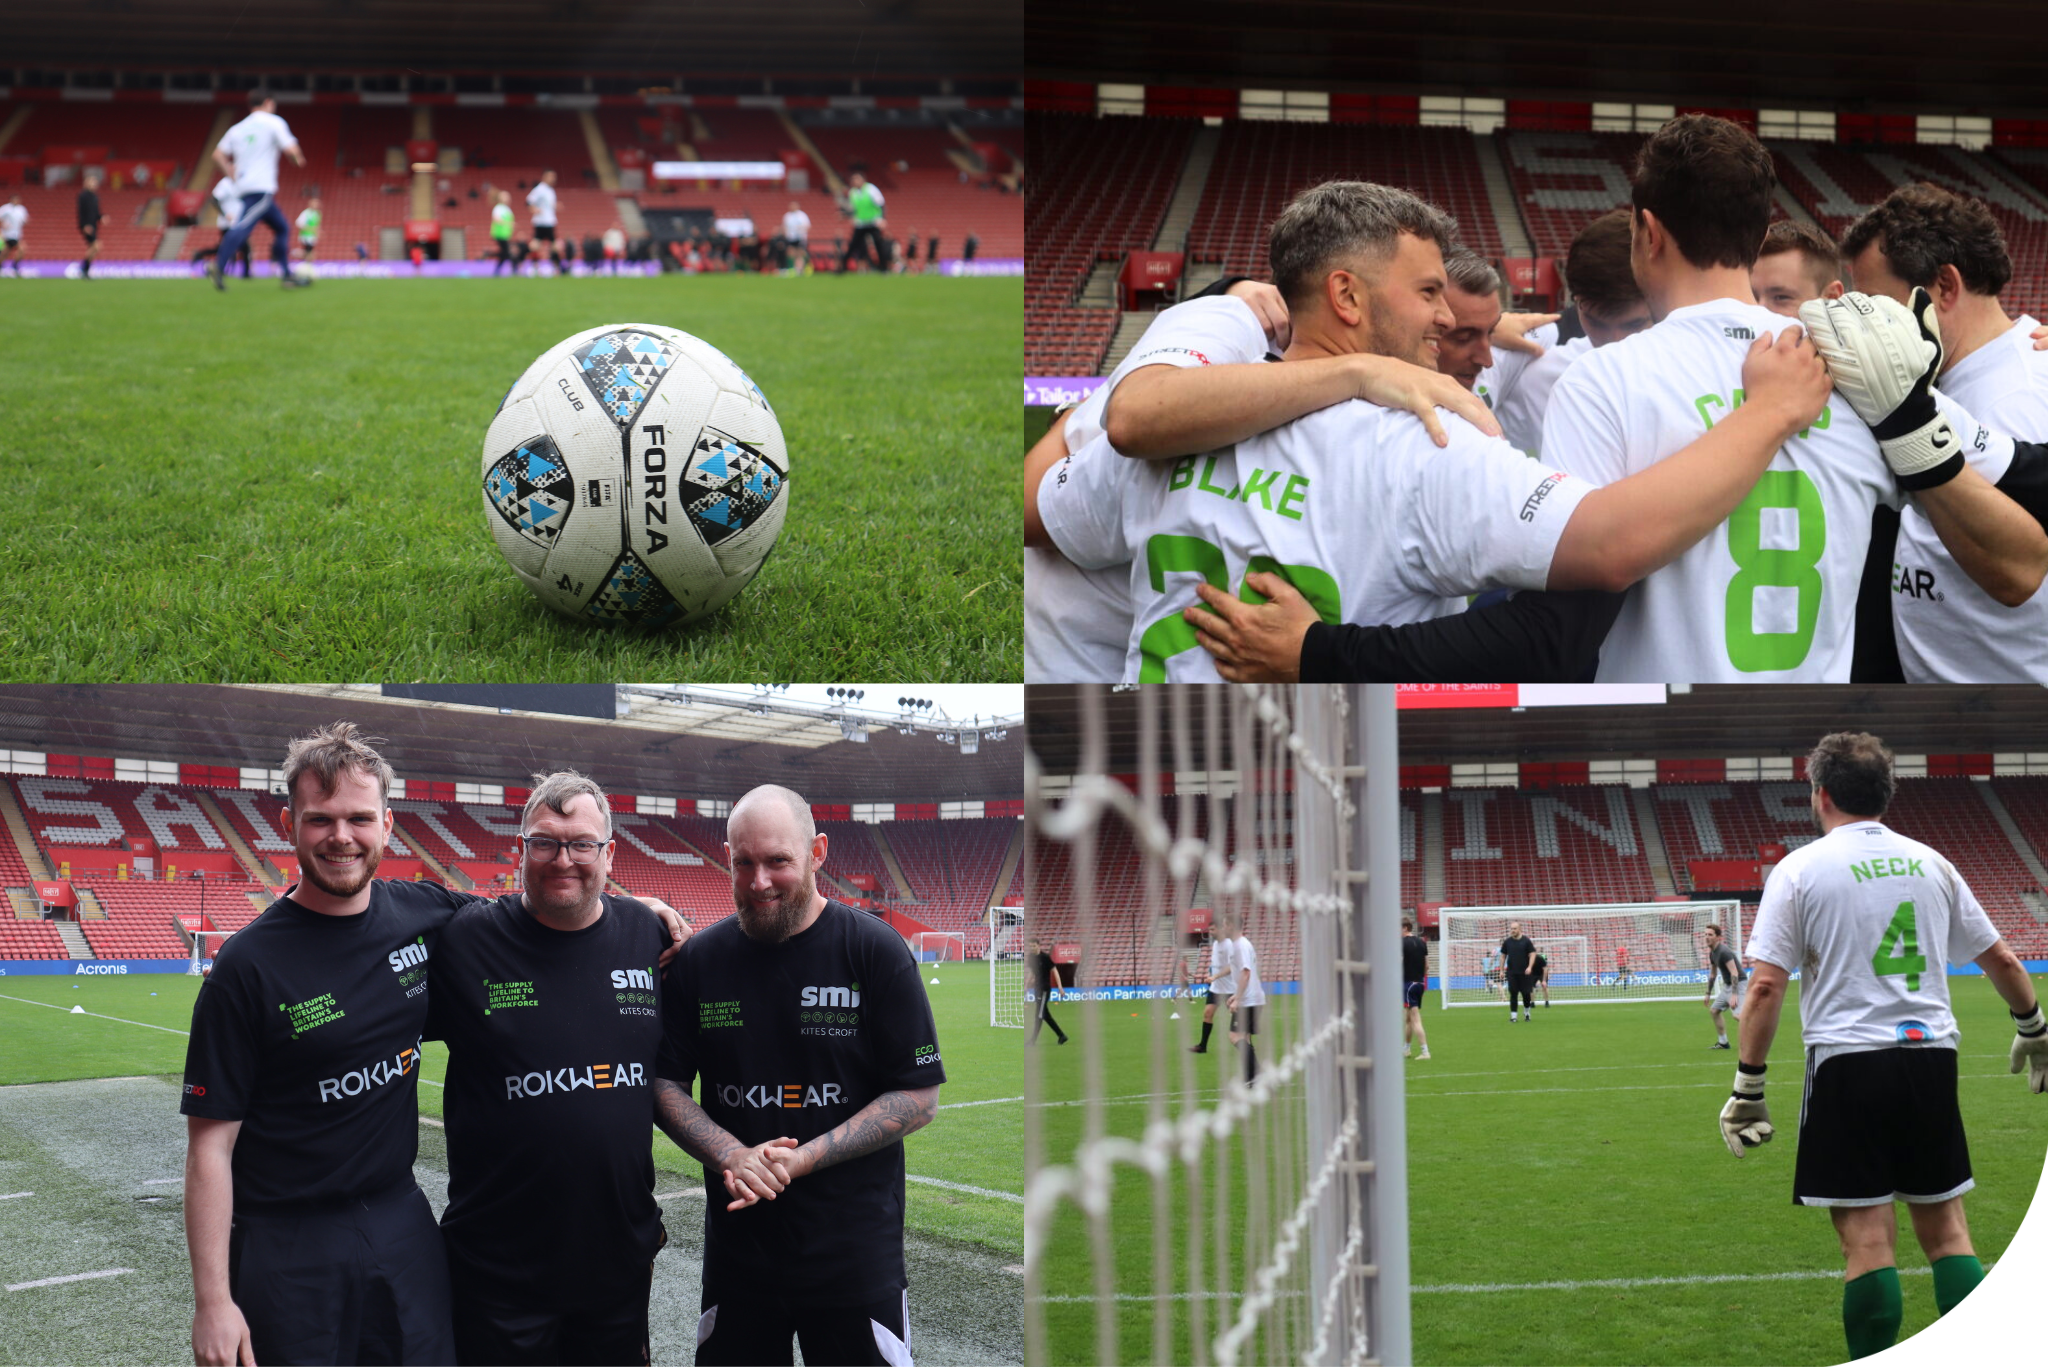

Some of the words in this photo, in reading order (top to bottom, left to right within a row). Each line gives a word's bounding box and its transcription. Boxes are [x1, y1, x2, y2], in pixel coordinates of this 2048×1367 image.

[1723, 326, 1756, 340] smi
[558, 378, 585, 412] CLUB
[642, 424, 669, 556] FORZA
[1724, 469, 1826, 673] 8
[556, 573, 574, 593] 4
[1850, 857, 1926, 884] NECK
[388, 935, 428, 973] smi
[1871, 901, 1927, 992] 4
[75, 963, 128, 975] Acronis
[489, 983, 504, 991] THE
[504, 981, 533, 989] SUPPLY
[610, 966, 654, 991] smi
[489, 988, 522, 997] LIFELINE
[490, 994, 526, 1004] BRITAIN'S
[800, 981, 860, 1008] smi
[287, 1001, 304, 1014] THE
[303, 992, 332, 1008] SUPPLY
[290, 1003, 325, 1021] LIFELINE
[324, 999, 336, 1007] TO
[490, 1000, 539, 1010] WORKFORCE
[714, 1000, 741, 1008] SUPPLY
[292, 1008, 332, 1027] BRITAIN'S
[619, 1007, 642, 1016] KITES
[700, 1007, 729, 1016] LIFELINE
[700, 1013, 733, 1022] BRITAIN'S
[295, 1009, 346, 1034] WORKFORCE
[701, 1019, 744, 1029] WORKFORCE
[800, 1027, 827, 1037] KITES
[828, 1028, 858, 1038] CROFT
[915, 1044, 935, 1057] ECO
